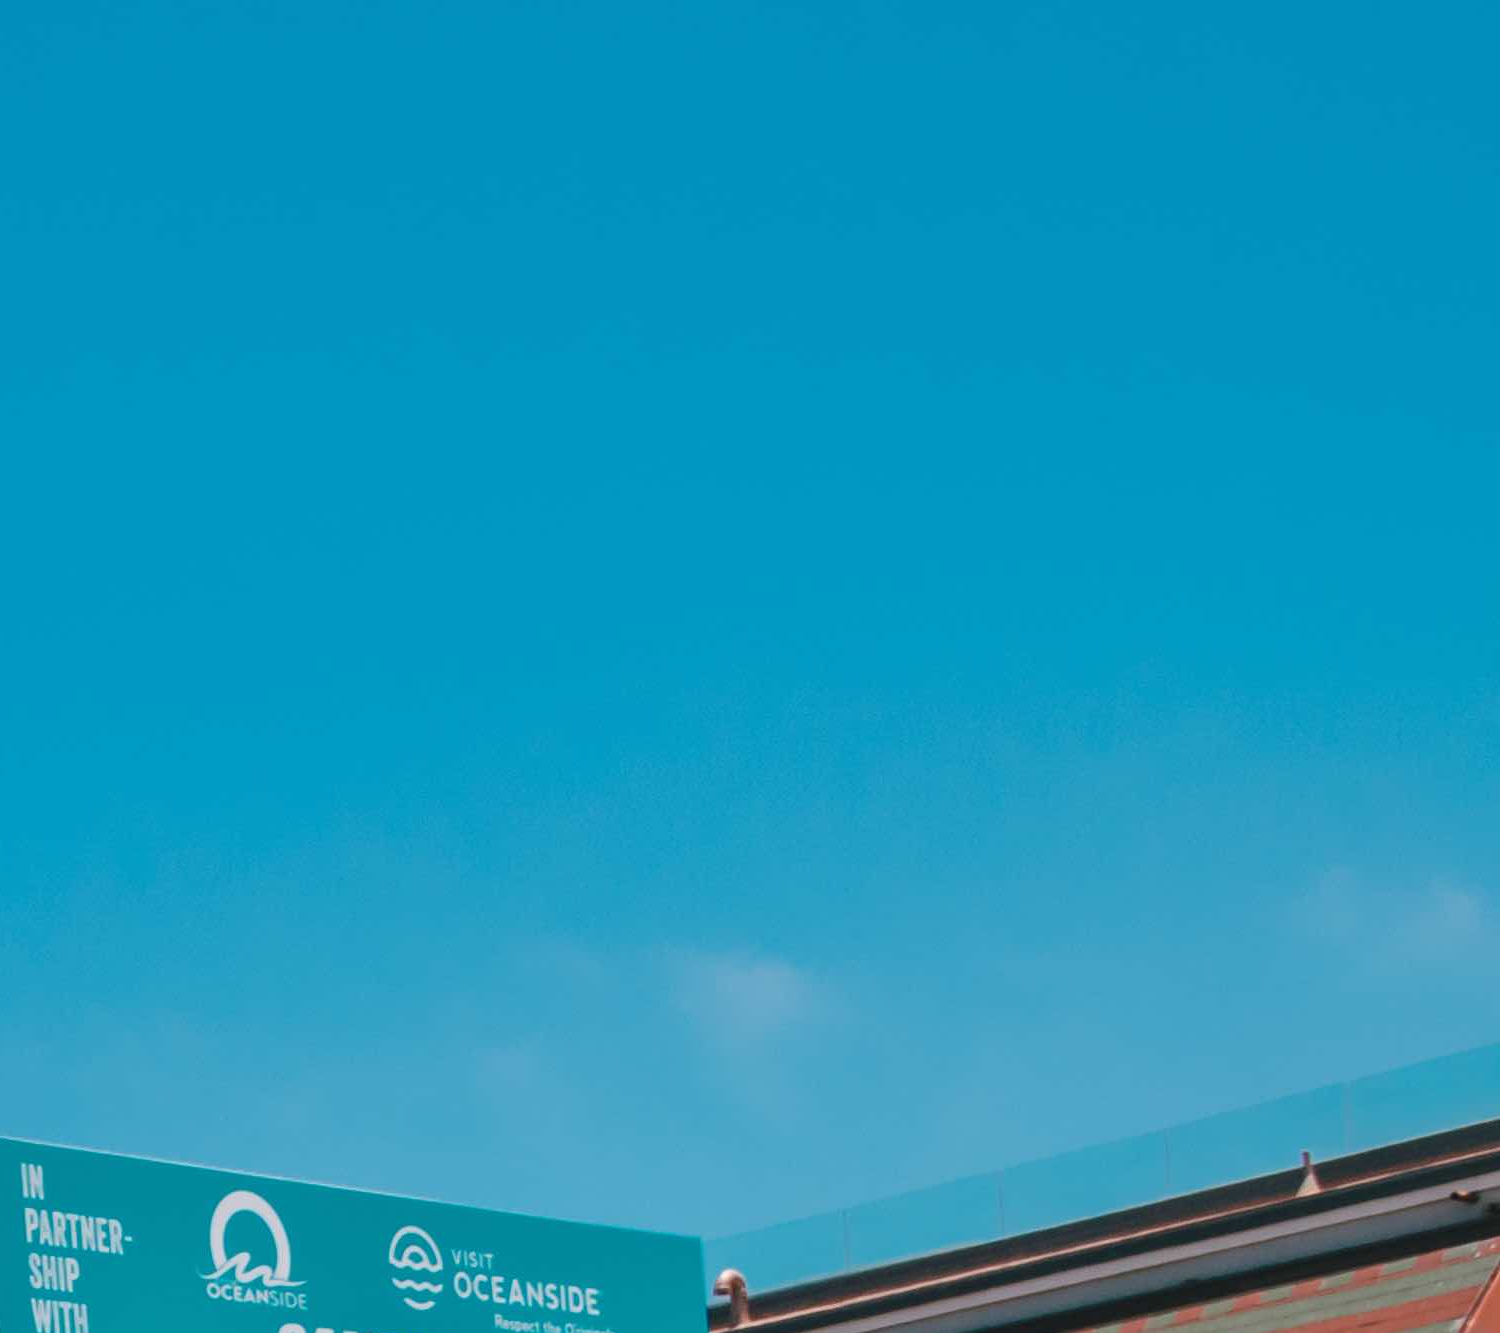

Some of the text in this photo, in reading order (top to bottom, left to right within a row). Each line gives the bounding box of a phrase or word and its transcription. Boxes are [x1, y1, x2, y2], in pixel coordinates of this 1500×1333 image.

[20, 1163, 44, 1200] IN
[24, 1207, 133, 1255] PARTNER-
[28, 1253, 80, 1293] SHIP
[451, 1249, 494, 1270] VISIT
[206, 1281, 308, 1310] OCEANSIDE
[453, 1271, 601, 1316] OCEANSIDE
[493, 1313, 540, 1333] Respect
